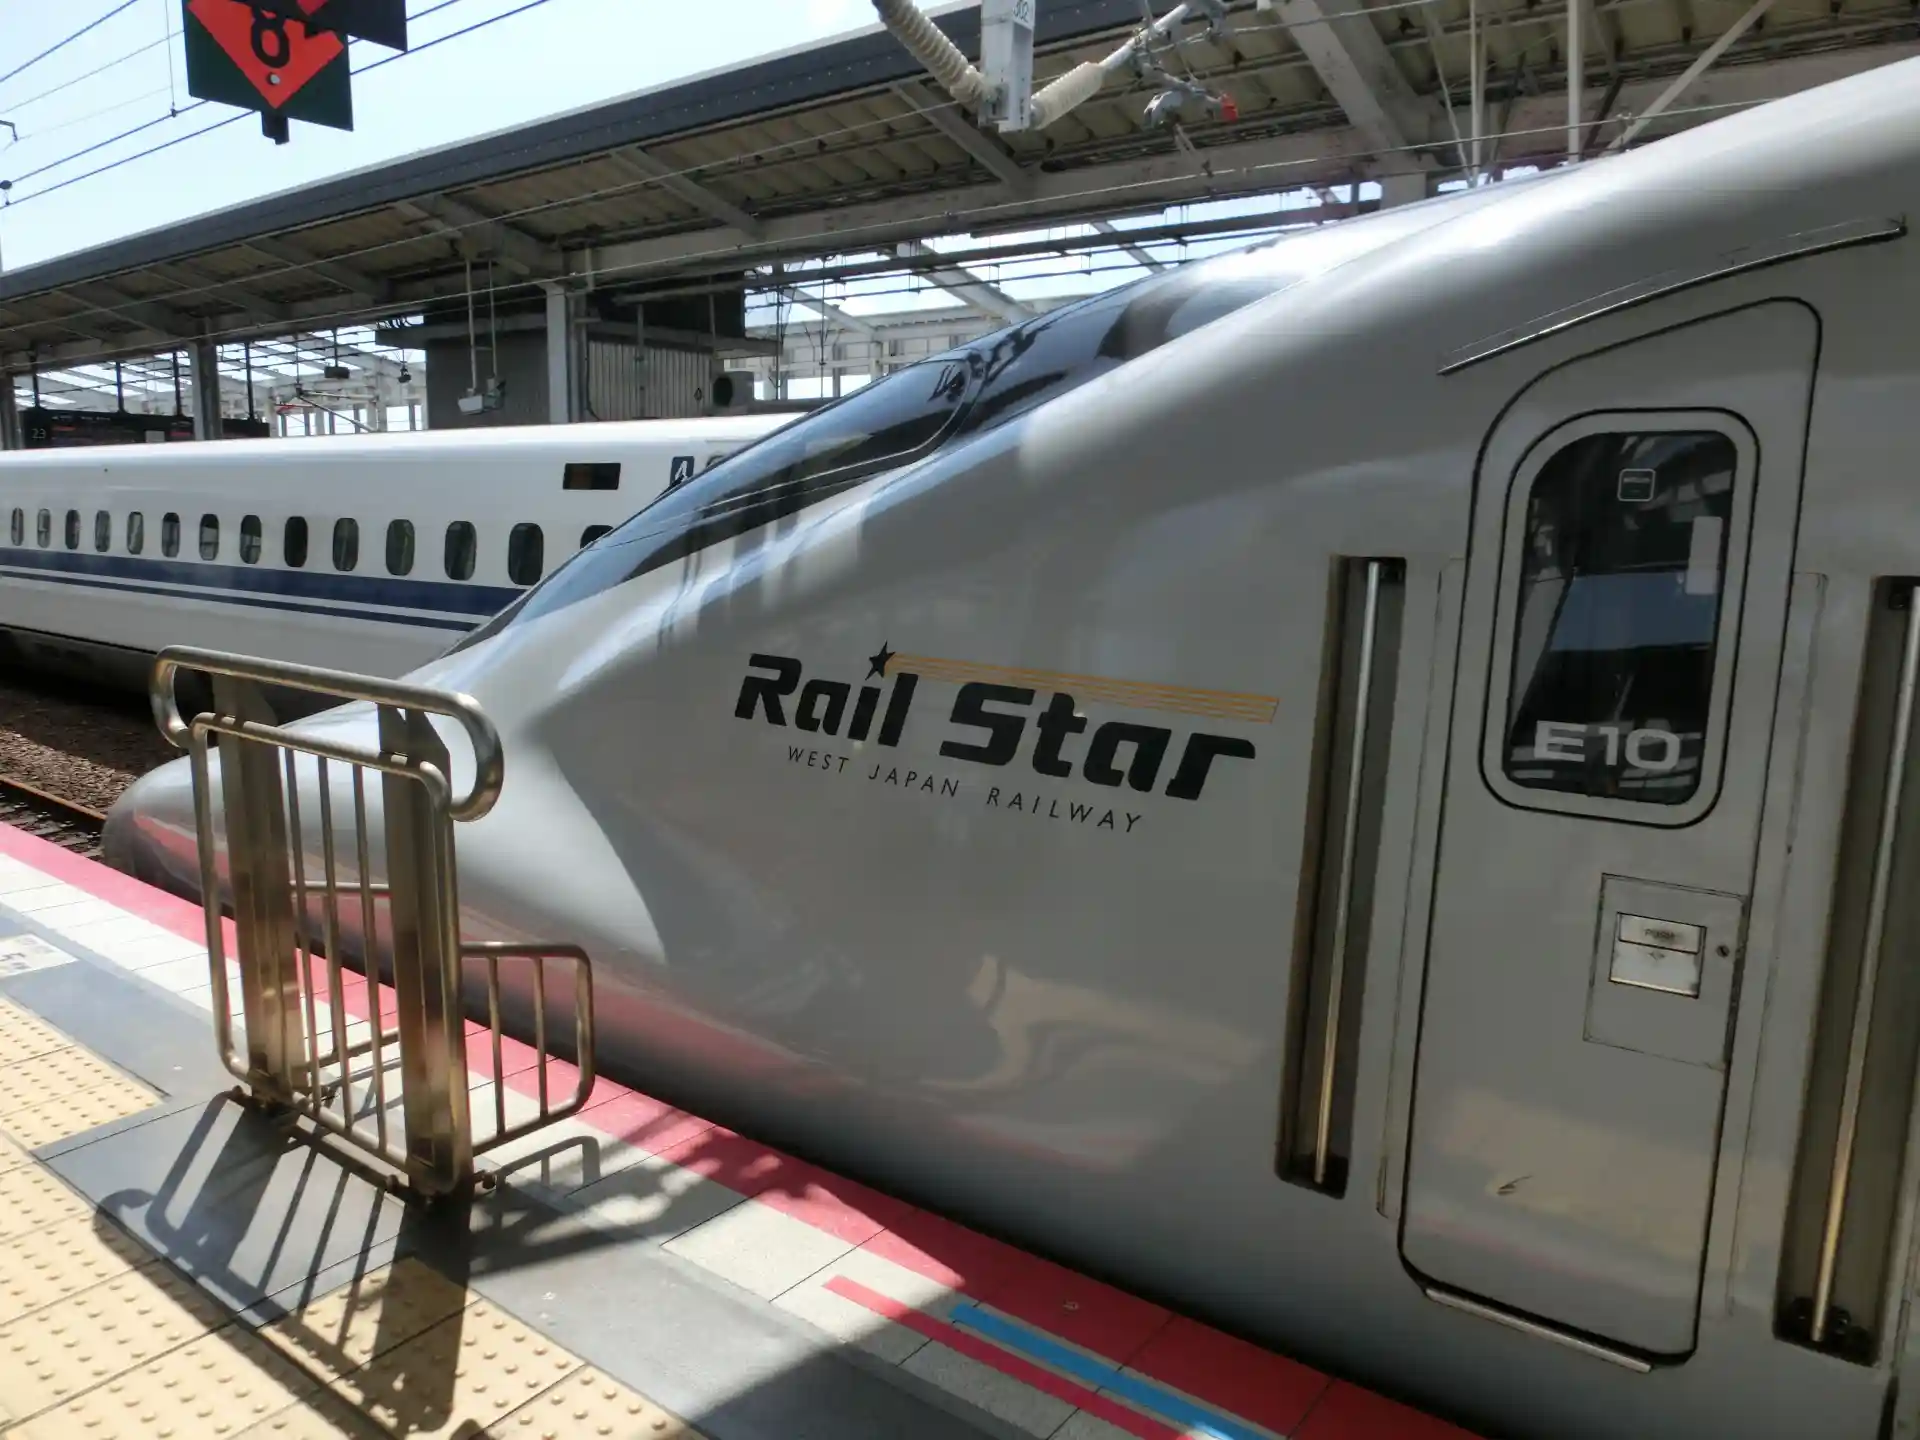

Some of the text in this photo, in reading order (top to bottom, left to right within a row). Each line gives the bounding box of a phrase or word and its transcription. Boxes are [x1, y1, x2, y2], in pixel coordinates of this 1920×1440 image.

[734, 641, 1256, 801] Rail Star
[1534, 720, 1680, 770] E10
[788, 745, 1143, 834] WEST JAPAN RAILWAY
